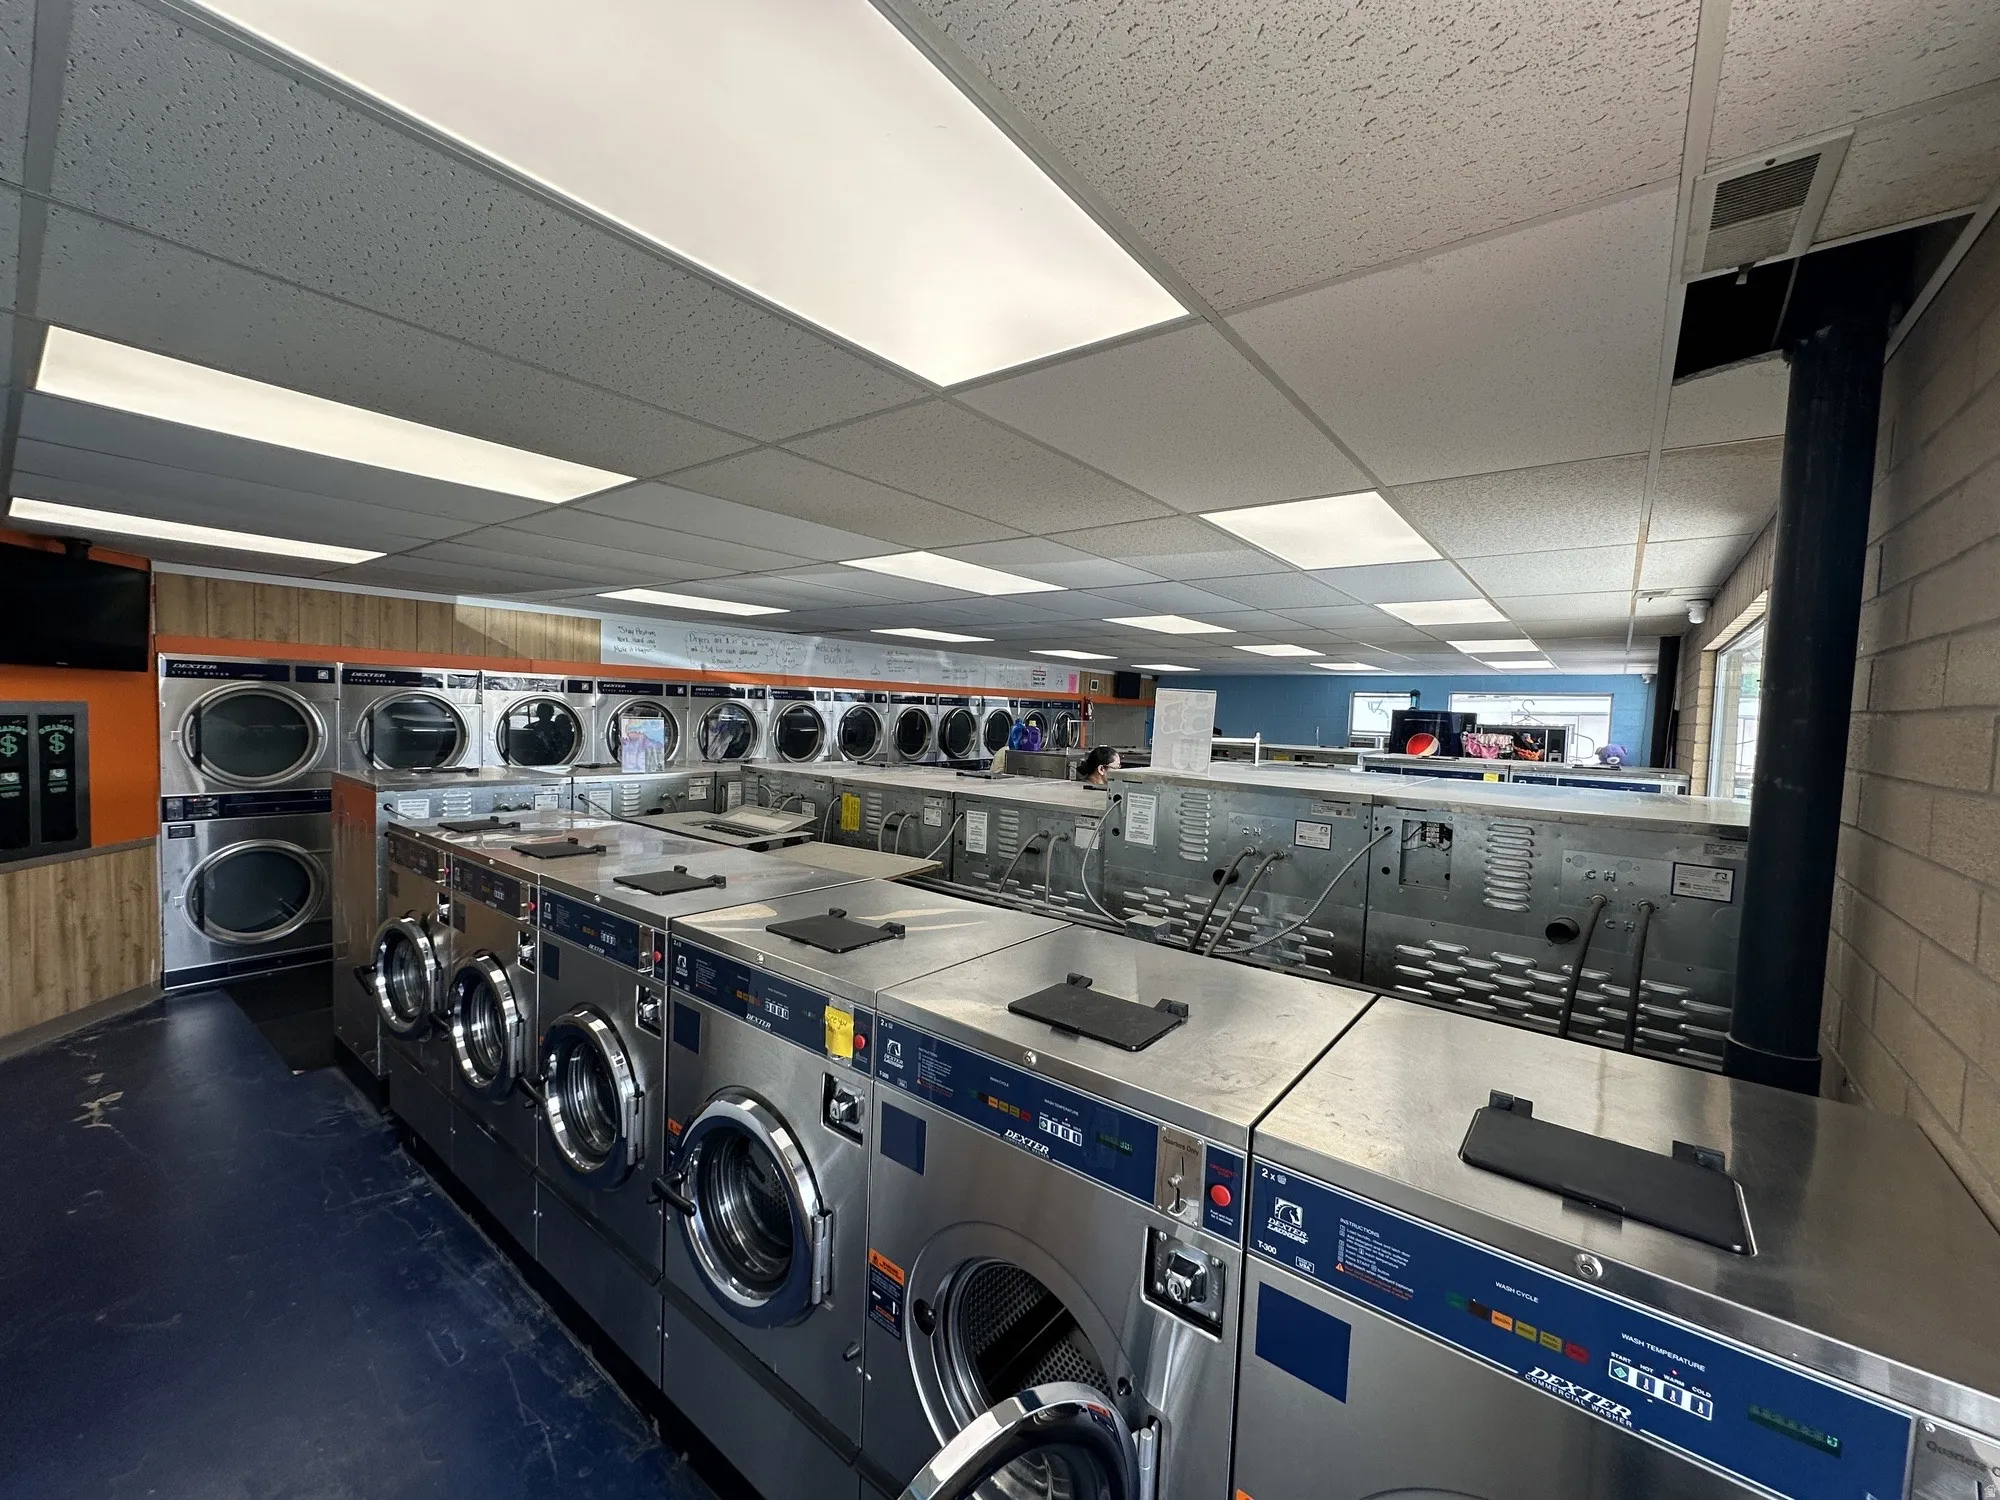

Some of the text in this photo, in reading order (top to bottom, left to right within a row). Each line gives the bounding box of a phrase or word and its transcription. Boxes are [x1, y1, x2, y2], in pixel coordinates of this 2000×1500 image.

[690, 632, 710, 645] Dryers
[0, 724, 28, 736] ANGE
[1585, 869, 1616, 882] C H
[1604, 918, 1616, 930] C
[588, 944, 605, 955] DEXTER
[746, 1014, 772, 1028] DEXTER
[884, 1053, 904, 1065] DEXTER
[1004, 1129, 1050, 1155] DEXTER
[1162, 1136, 1200, 1157] Quarters Only
[1261, 1168, 1269, 1179] 2
[1266, 1224, 1309, 1245] LAUNDRY
[1268, 1217, 1309, 1240] DEXTER
[1340, 1217, 1380, 1238] INSTRUCTIONS
[1257, 1240, 1277, 1255] T-300
[1496, 1281, 1539, 1304] WASH CYCLE
[1621, 1332, 1706, 1373] WASH TEMPERATURE
[1610, 1352, 1712, 1399] START HOT WARM COLD
[1524, 1374, 1632, 1428] COMMERCIAL WASHER
[1527, 1366, 1632, 1421] DEXTER
[1926, 1440, 1988, 1472] Quarters
